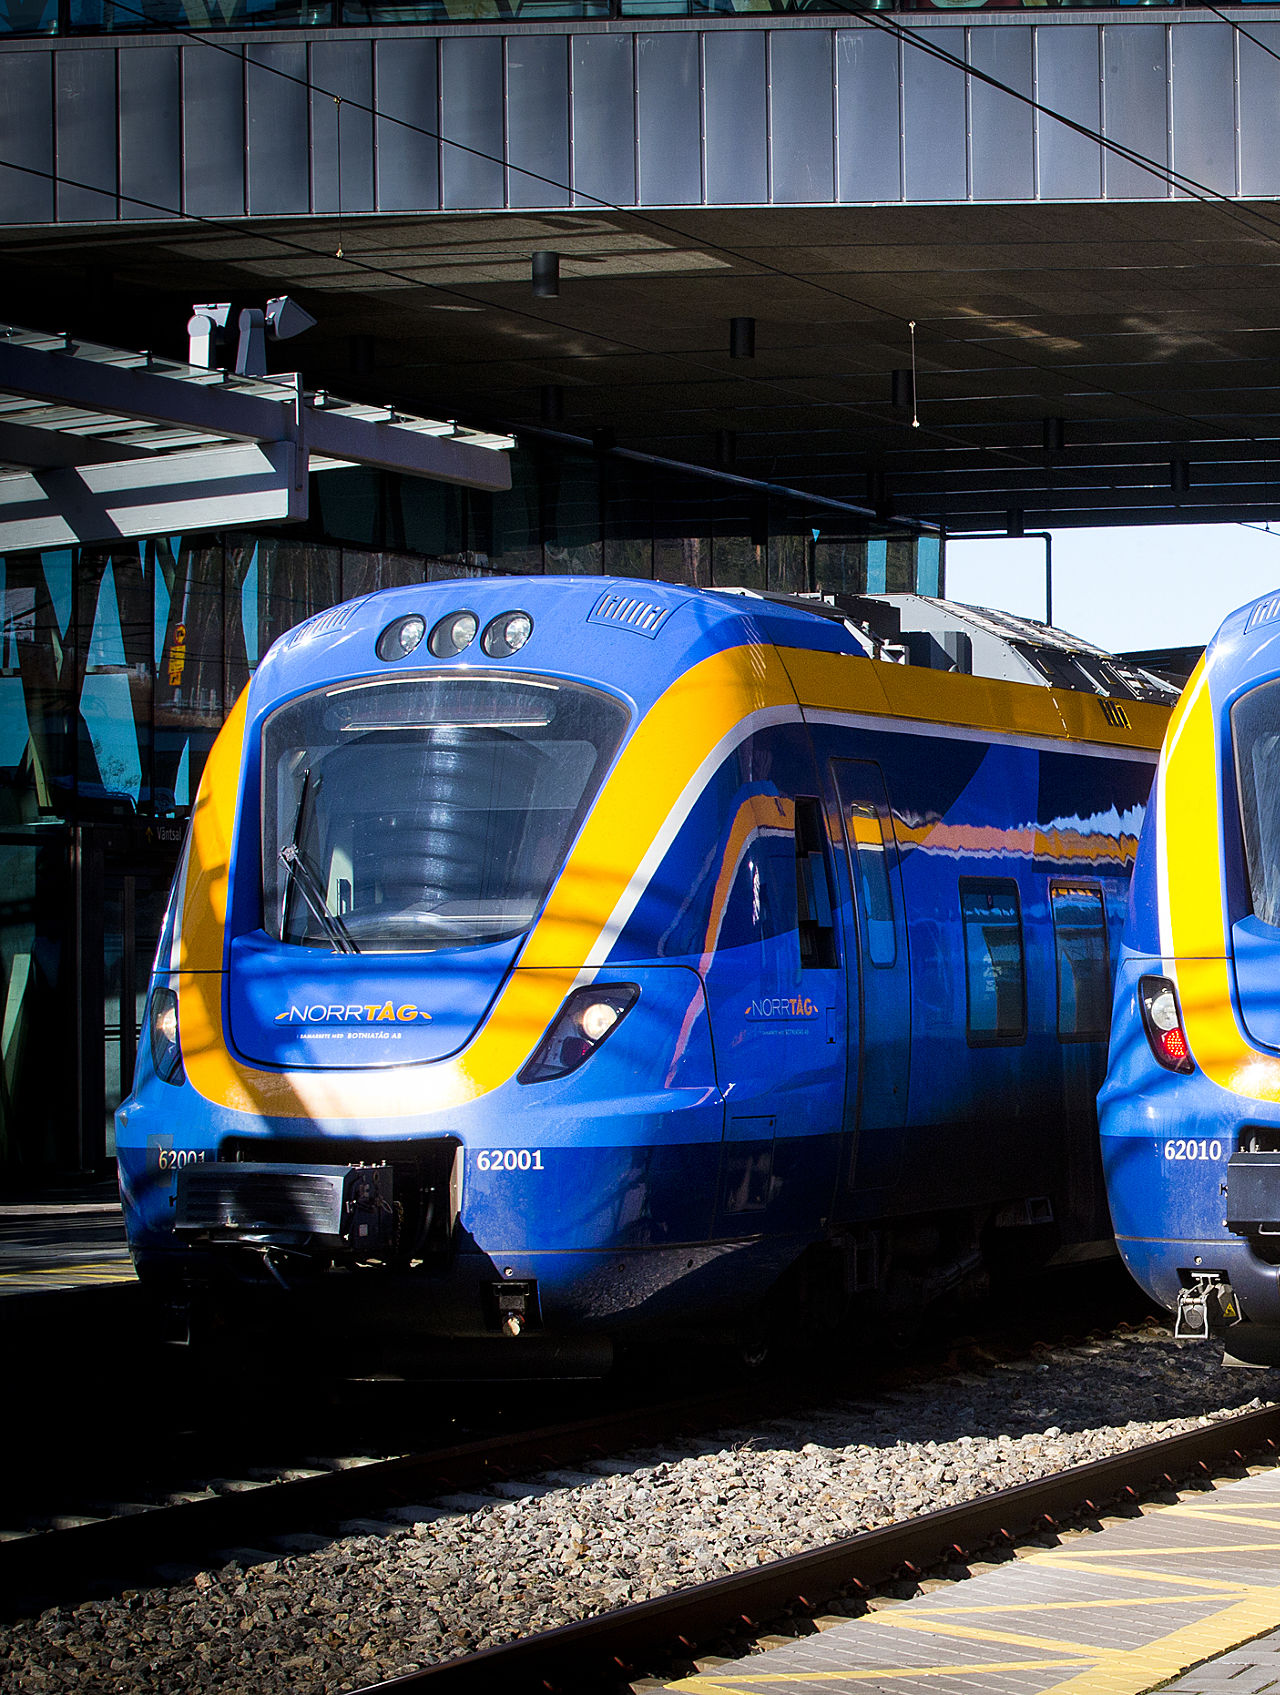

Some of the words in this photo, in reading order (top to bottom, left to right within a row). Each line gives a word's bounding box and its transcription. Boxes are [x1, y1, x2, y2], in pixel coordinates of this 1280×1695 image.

[289, 1000, 418, 1022] NORRTÅG
[752, 994, 813, 1016] NORRTÅG
[347, 1031, 390, 1039] BOTNIATÅG
[158, 1150, 205, 1170] 62001
[476, 1149, 544, 1171] 62001
[1164, 1139, 1222, 1161] 62010
